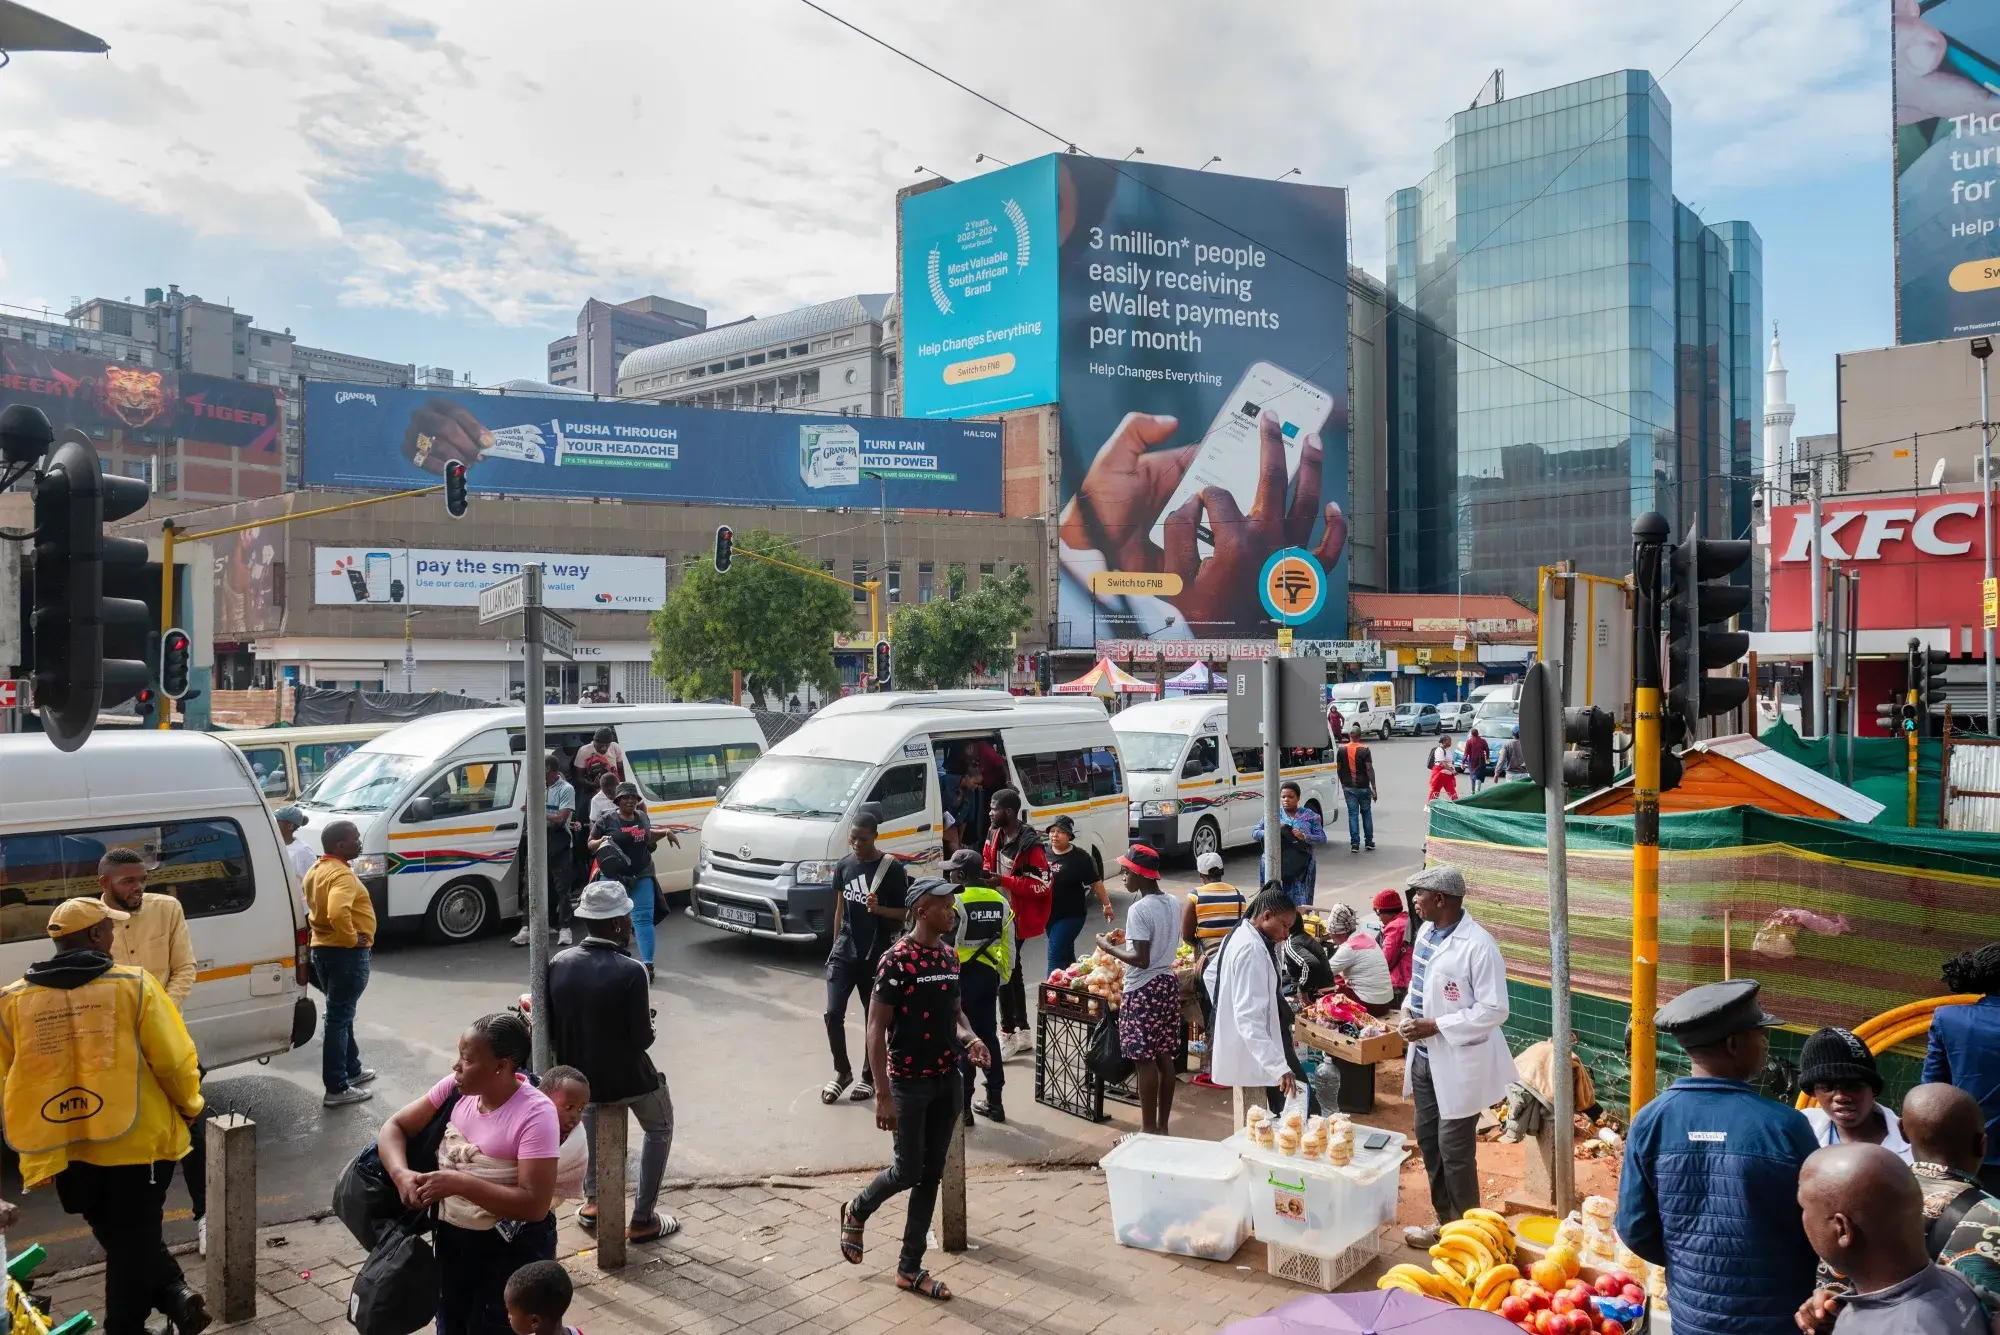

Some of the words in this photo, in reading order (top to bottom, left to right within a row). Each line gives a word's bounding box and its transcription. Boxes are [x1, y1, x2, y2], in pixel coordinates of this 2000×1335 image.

[1951, 179, 1996, 204] for
[965, 222, 970, 230] 2
[971, 218, 989, 228] Years
[1952, 219, 1994, 238] Help
[957, 225, 998, 243] 2023-2024
[1089, 226, 1103, 250] 3
[1194, 244, 1266, 271] people
[948, 262, 969, 275] Most
[970, 251, 1008, 270] Valuable
[948, 274, 974, 288] South
[975, 265, 1008, 283] African
[1089, 261, 1151, 291] easily
[1156, 270, 1252, 302] receiving
[964, 281, 992, 298] Brand
[1089, 290, 1170, 319] eWallet
[1175, 302, 1280, 330] payments
[1969, 321, 1997, 330] National
[918, 342, 940, 357] Help
[942, 333, 985, 352] Changes
[986, 321, 1042, 344] Everything
[1090, 326, 1127, 349] per
[1131, 329, 1202, 353] month
[957, 363, 979, 377] Switch
[979, 364, 987, 373] to
[987, 360, 1001, 371] FNB
[1089, 362, 1115, 377] Help
[1117, 364, 1163, 381] Changes
[1165, 369, 1222, 387] Everything
[335, 391, 378, 407] GRAND-PA
[187, 397, 267, 427] TIGER
[565, 423, 610, 436] PUSHA
[613, 425, 677, 439] THROUGH
[963, 430, 997, 439] HALEON
[567, 441, 603, 452] YOUR
[606, 443, 675, 456] HEADACHE
[823, 446, 857, 459] GRAND-PA
[864, 439, 896, 450] TURN
[899, 441, 925, 451] PAIN
[863, 456, 890, 466] INTO
[894, 457, 935, 467] POWER
[1779, 502, 1979, 562] KFC
[416, 558, 450, 575] pay
[456, 558, 487, 573] the
[492, 561, 547, 575] smt
[552, 564, 590, 580] way
[416, 578, 432, 588] Use
[547, 582, 575, 591] wallet
[1107, 578, 1136, 588] Switch
[1137, 579, 1146, 588] to
[1147, 579, 1163, 588] FNB
[1120, 643, 1184, 657] SUPERIOR
[1187, 643, 1227, 657] FRESH
[1231, 643, 1272, 657] MEATS
[843, 889, 868, 905] adida
[726, 908, 734, 918] 57
[60, 1097, 88, 1114] MTN
